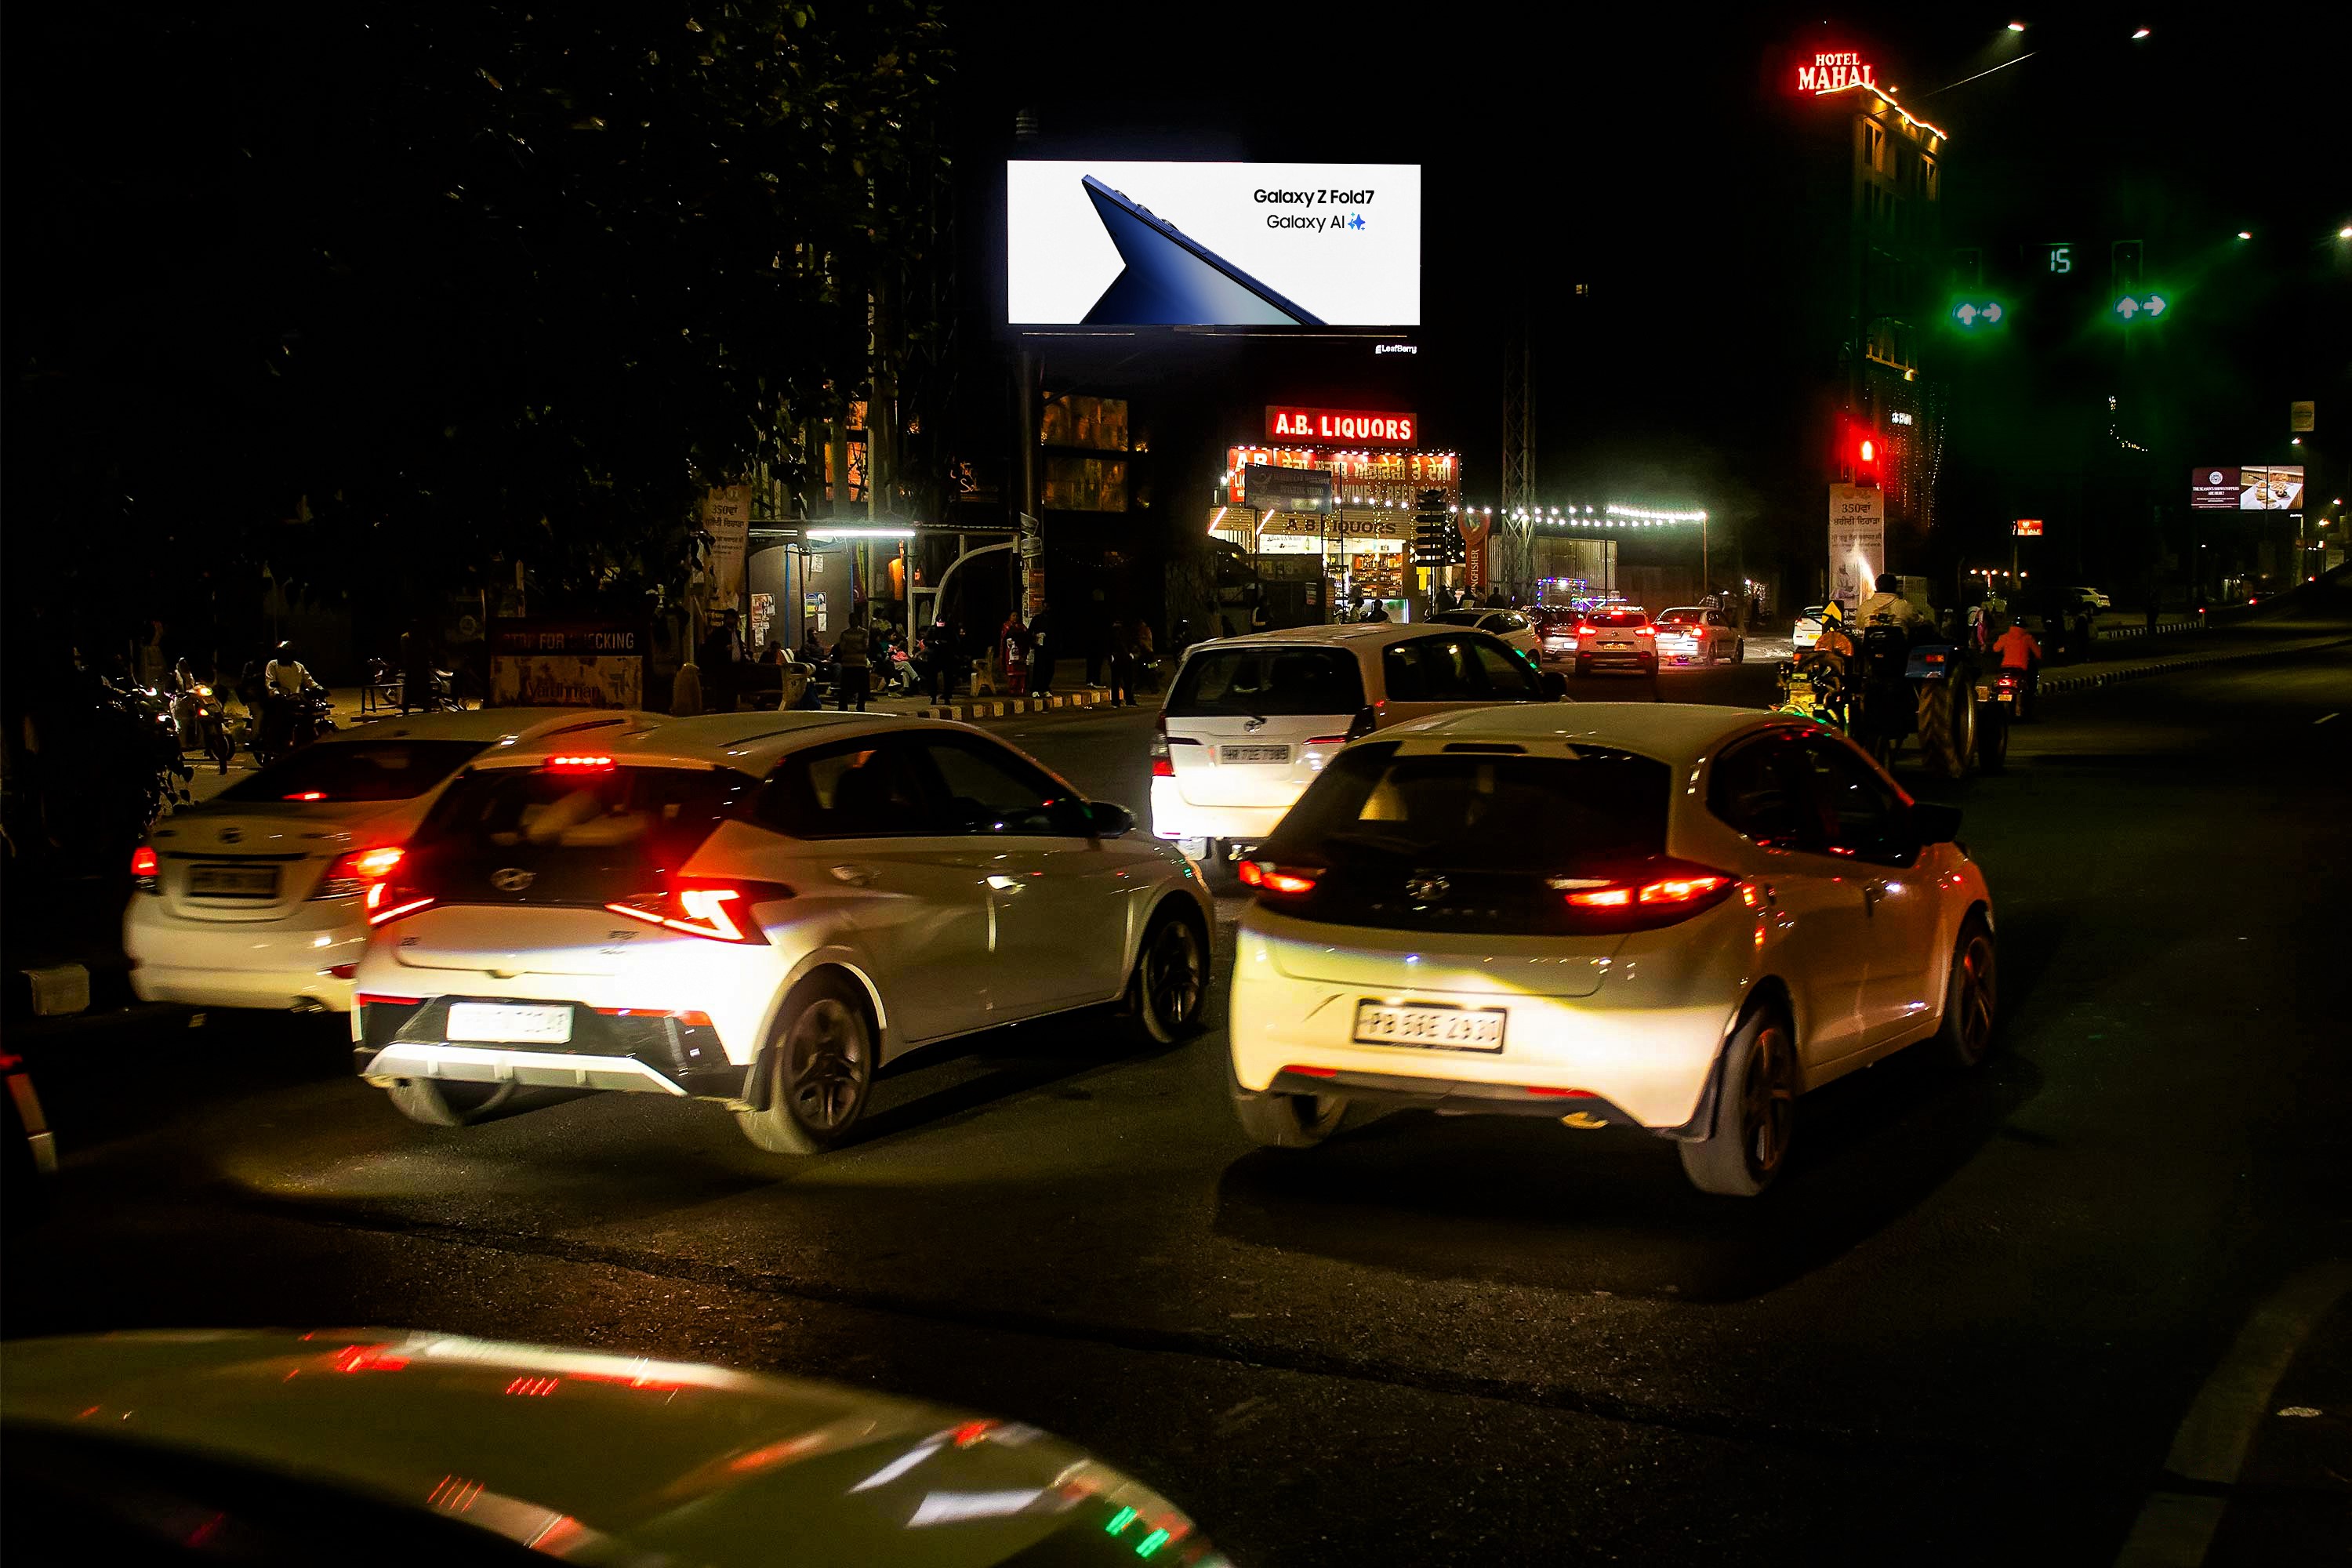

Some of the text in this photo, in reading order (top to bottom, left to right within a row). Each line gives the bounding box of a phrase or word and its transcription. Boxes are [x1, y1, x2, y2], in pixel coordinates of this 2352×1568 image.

[1815, 53, 1860, 67] HOTEL
[1798, 65, 1875, 90] MAHAL
[1254, 189, 1374, 208] Galaxy Z Fold7
[1267, 214, 1345, 233] Galaxy AI
[2050, 249, 2071, 273] 15
[1275, 413, 1411, 440] A.B. LIQUORS
[1341, 485, 1370, 503] WINE
[1387, 485, 1417, 504] BEER
[1323, 521, 1396, 535] IQUORS
[1471, 549, 1480, 593] INGFISHER
[539, 633, 564, 650] FOR
[566, 632, 634, 650] ECKING
